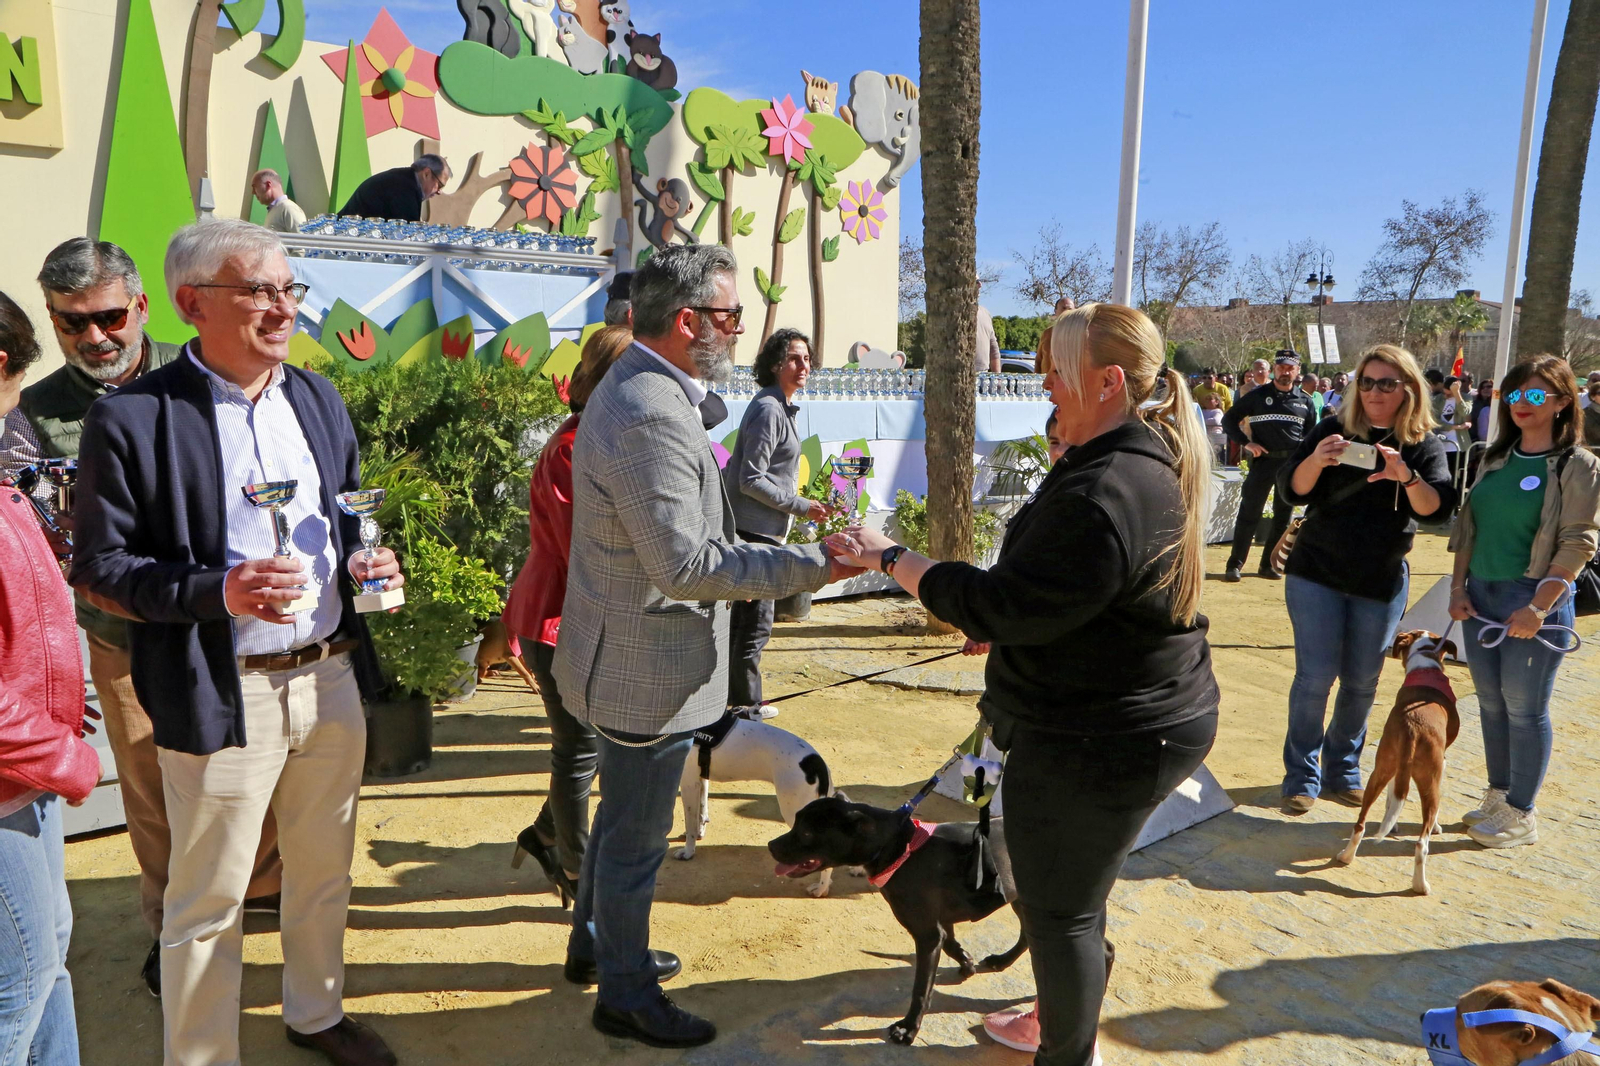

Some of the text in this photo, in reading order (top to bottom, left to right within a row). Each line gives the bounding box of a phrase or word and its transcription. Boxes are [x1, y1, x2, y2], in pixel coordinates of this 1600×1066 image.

[0, 32, 42, 106] N
[693, 730, 714, 742] URITY
[1428, 1032, 1451, 1049] XL
